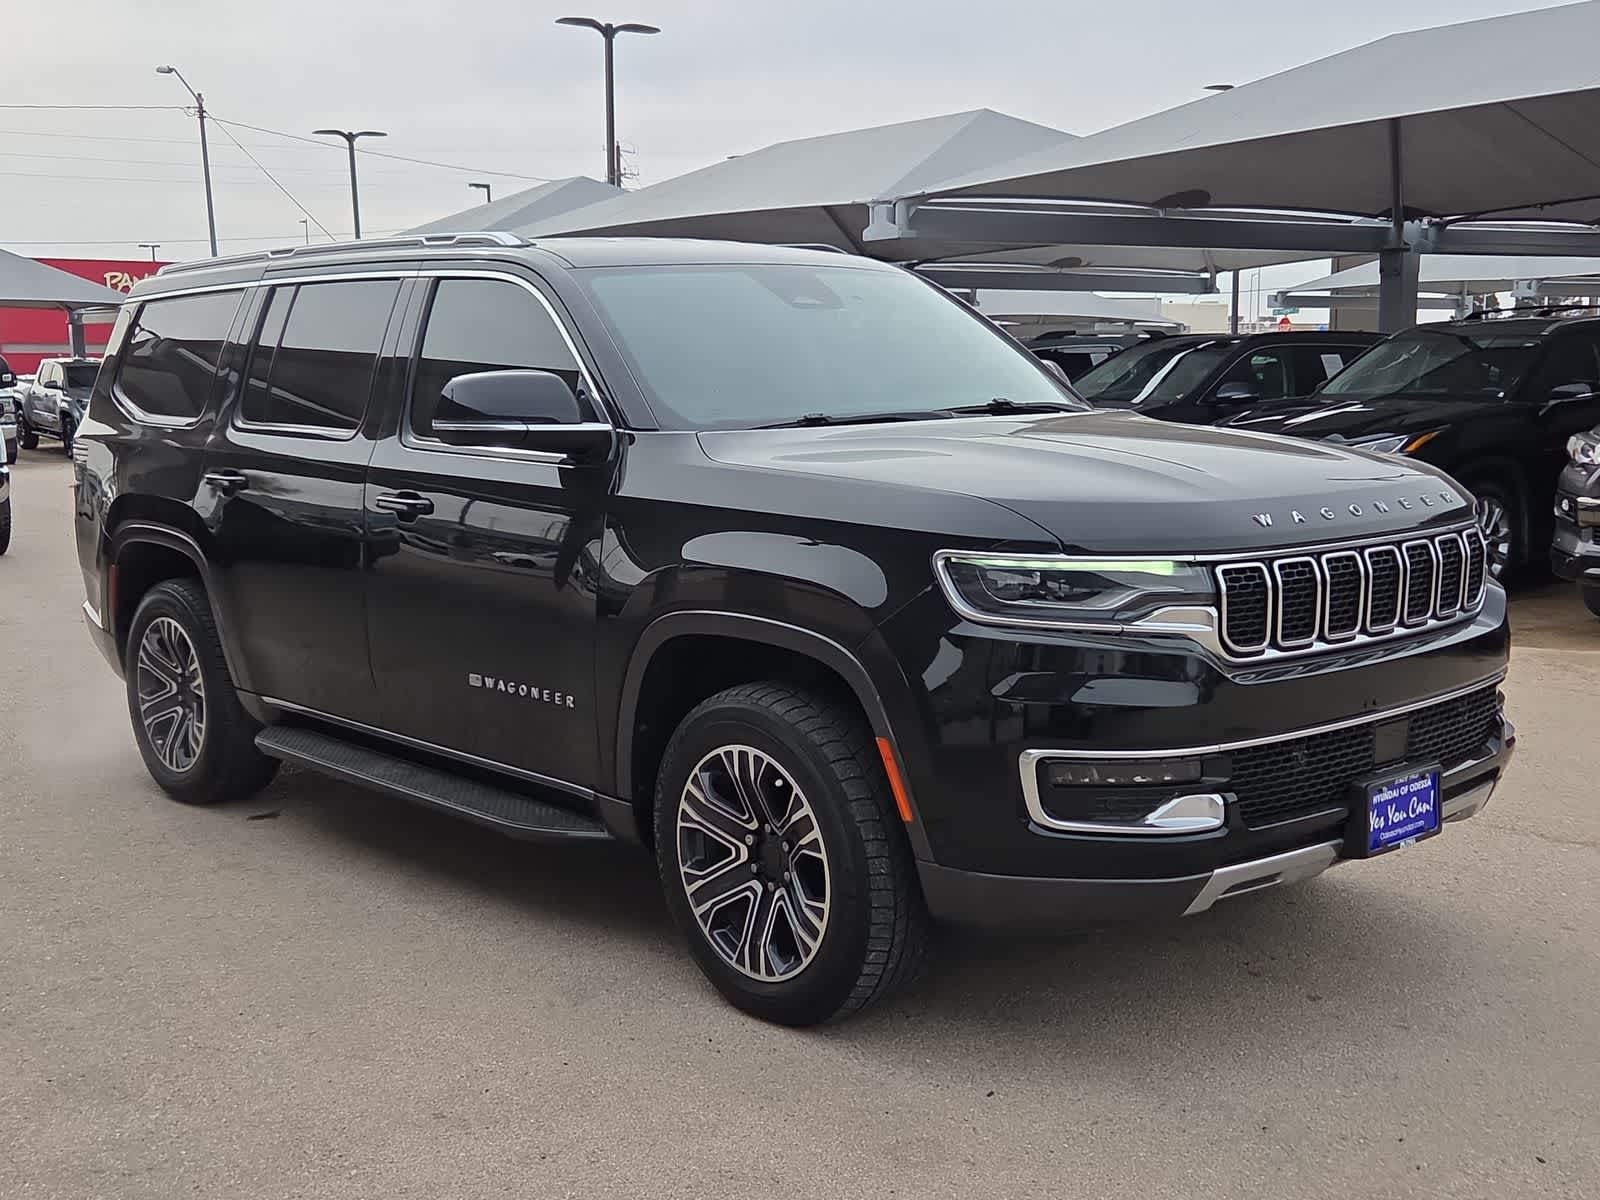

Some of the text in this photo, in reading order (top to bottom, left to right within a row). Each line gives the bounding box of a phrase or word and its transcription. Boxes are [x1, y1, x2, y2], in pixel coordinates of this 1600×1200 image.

[1252, 491, 1453, 527] WAGONEER
[484, 676, 575, 708] WAGONEER
[1400, 784, 1409, 796] OF
[1409, 778, 1432, 793] ODESSA
[1369, 790, 1434, 832] Yes You Can!
